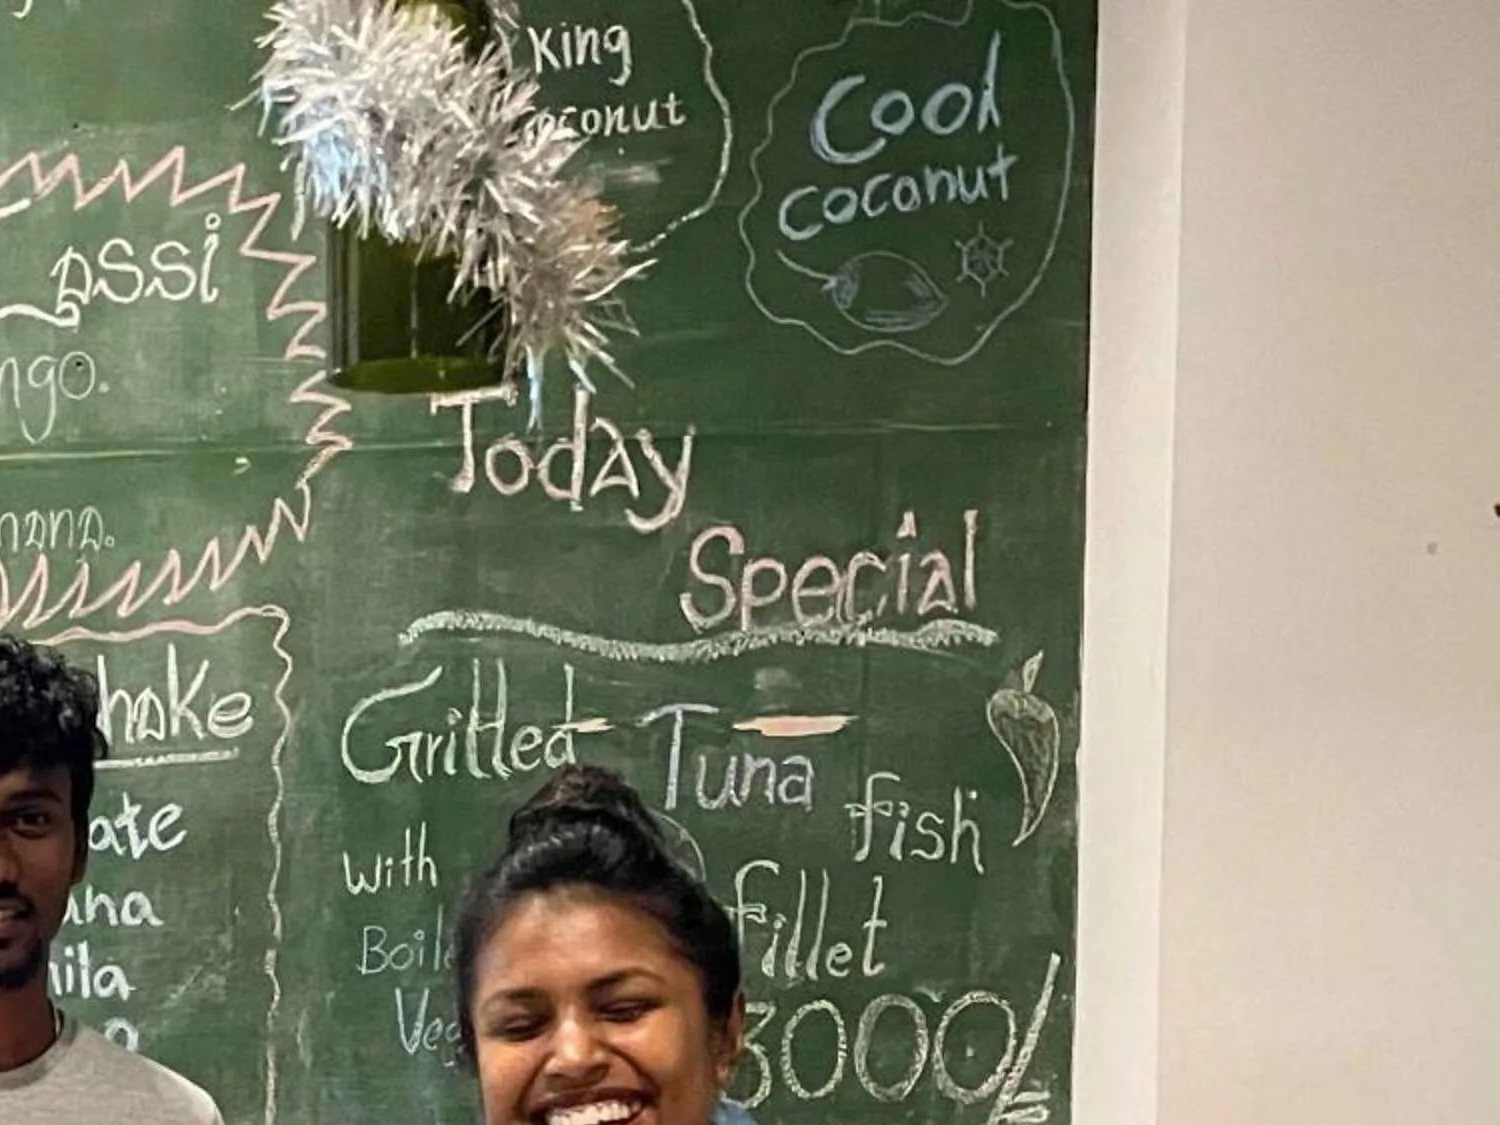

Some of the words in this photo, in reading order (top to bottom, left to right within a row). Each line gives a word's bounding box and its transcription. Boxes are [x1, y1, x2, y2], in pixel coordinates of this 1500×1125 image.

[527, 21, 633, 87] King
[809, 30, 1002, 165] Cool
[680, 508, 979, 632] Special
[96, 642, 255, 744] hake
[635, 702, 815, 812] Tuna
